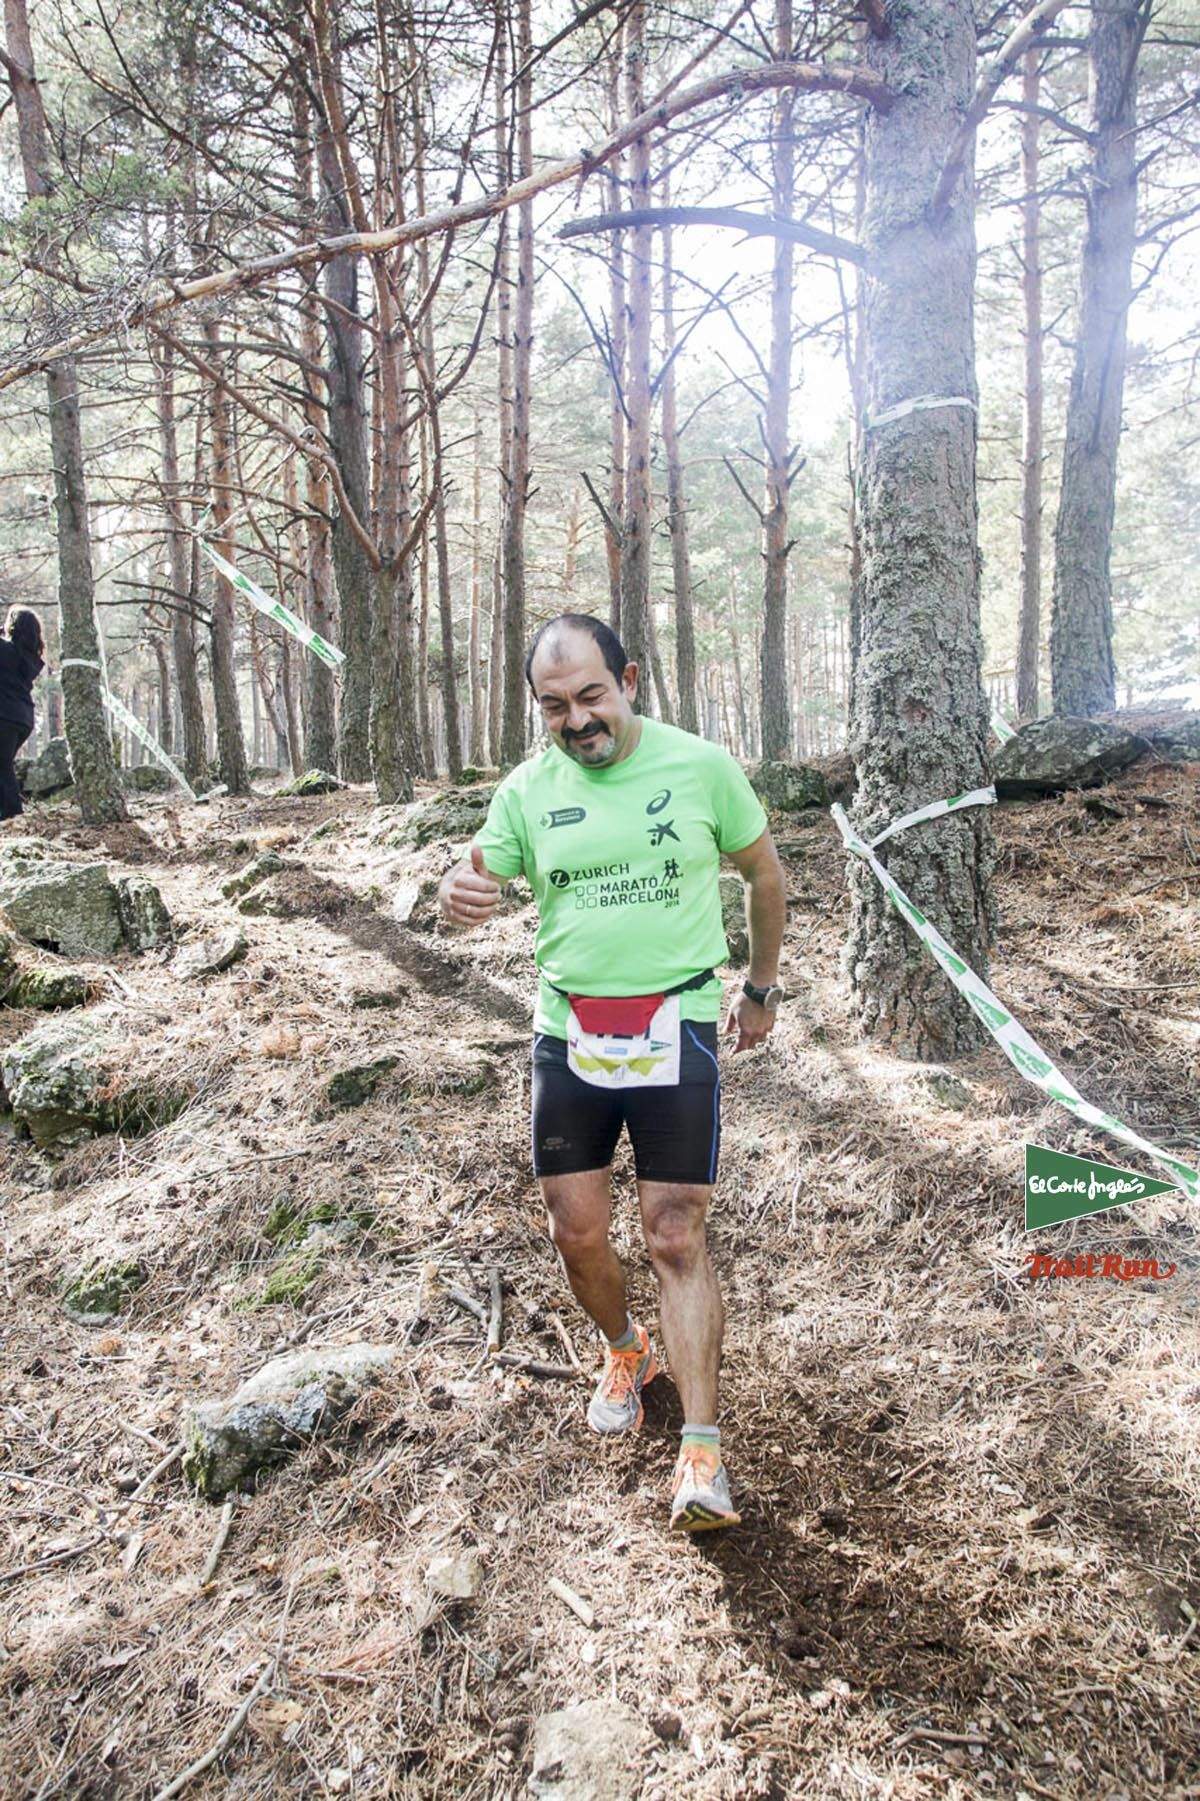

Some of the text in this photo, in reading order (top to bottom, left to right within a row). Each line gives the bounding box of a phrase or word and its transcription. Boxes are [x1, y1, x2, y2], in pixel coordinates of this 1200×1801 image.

[572, 863, 630, 881] ZURICH
[600, 875, 658, 893] MARATÓ
[600, 888, 679, 907] BARCELONA
